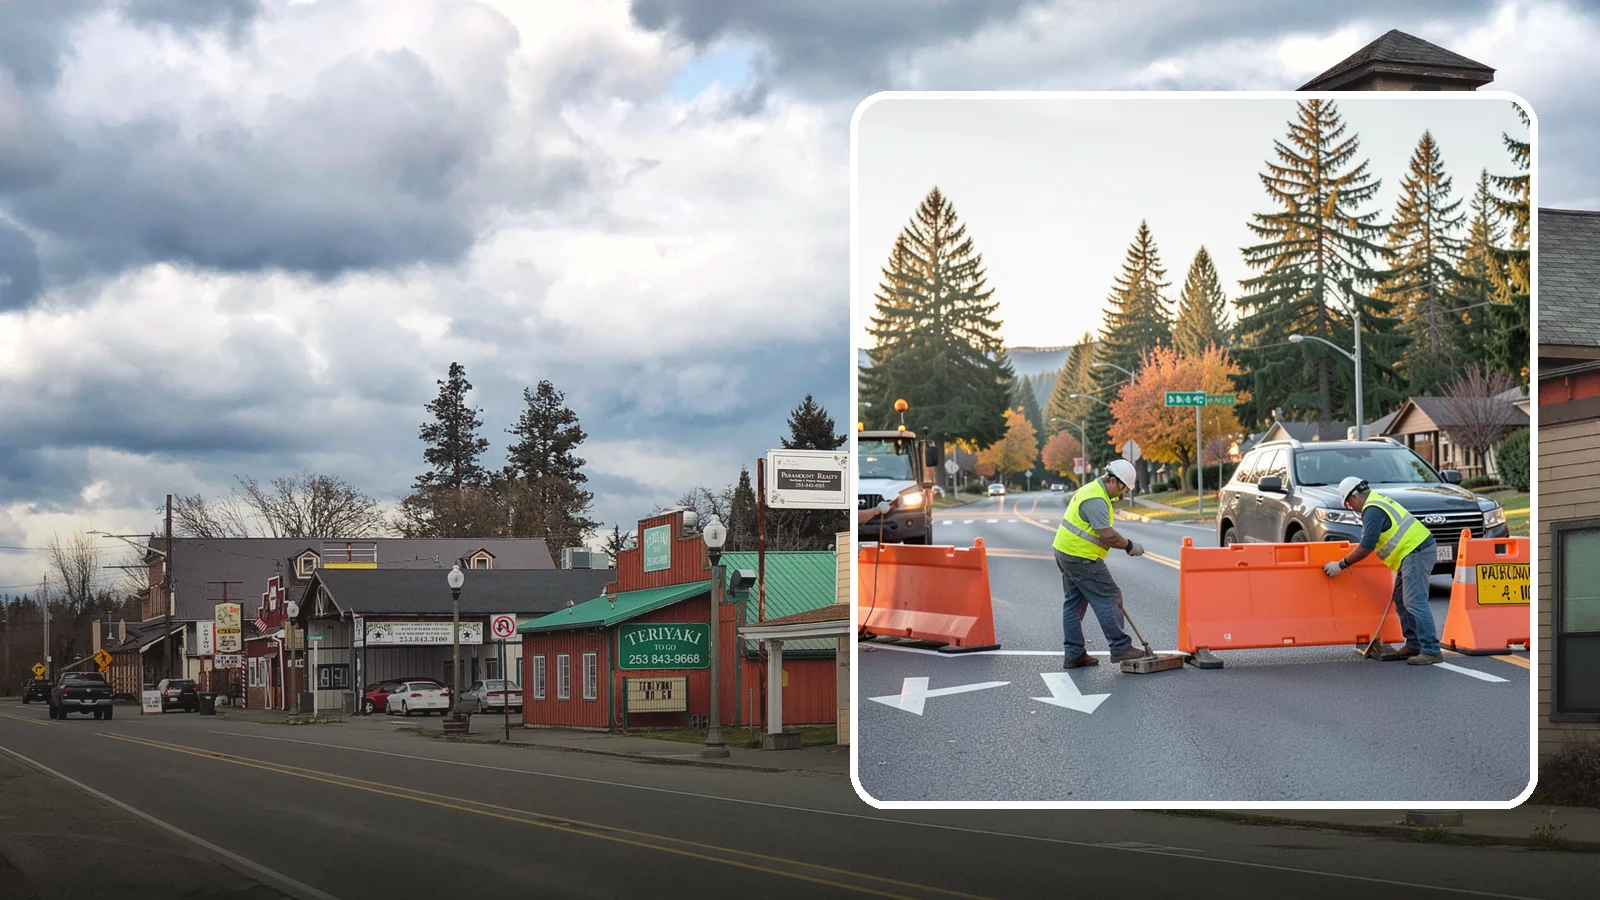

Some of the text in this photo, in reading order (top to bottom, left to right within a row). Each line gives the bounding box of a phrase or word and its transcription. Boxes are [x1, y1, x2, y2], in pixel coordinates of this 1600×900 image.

[646, 531, 668, 549] TERIYAKI
[625, 627, 702, 646] TERIYAKI
[629, 654, 700, 664] 253 843-9668
[639, 681, 672, 691] TERIYAKI
